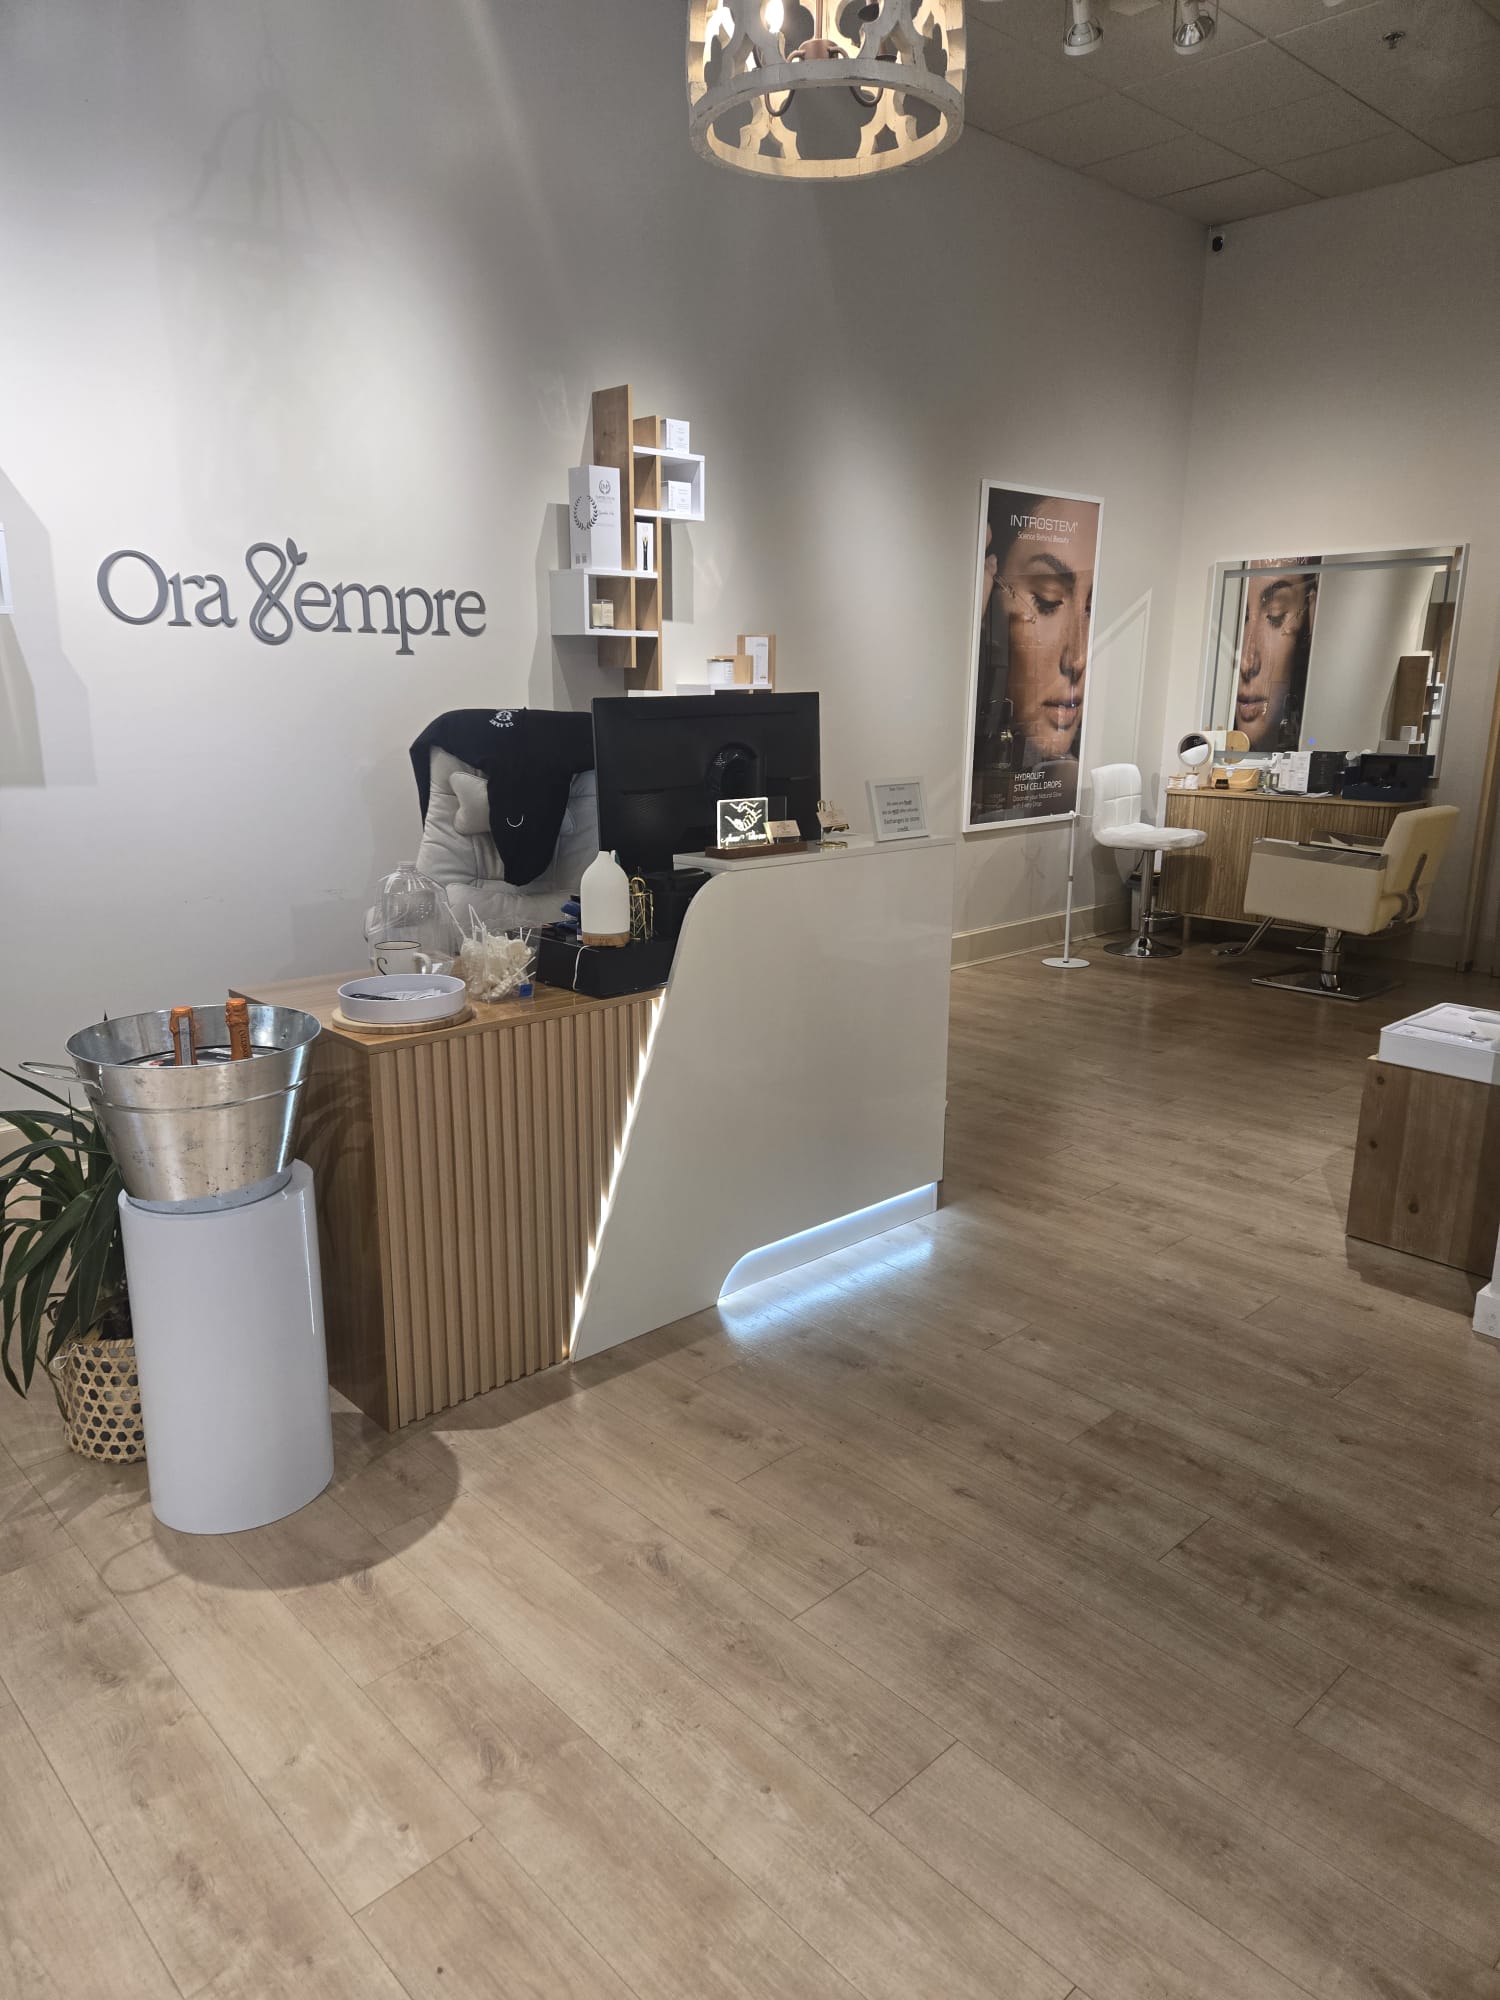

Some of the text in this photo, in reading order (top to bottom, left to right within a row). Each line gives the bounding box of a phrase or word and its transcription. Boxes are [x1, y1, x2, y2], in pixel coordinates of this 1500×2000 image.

[1017, 531, 1036, 541] Science
[1036, 533, 1053, 543] Behind
[97, 549, 238, 628] Ora
[1014, 771, 1046, 781] HYDROLIFT
[1013, 780, 1062, 793] STEM CELL DROPS
